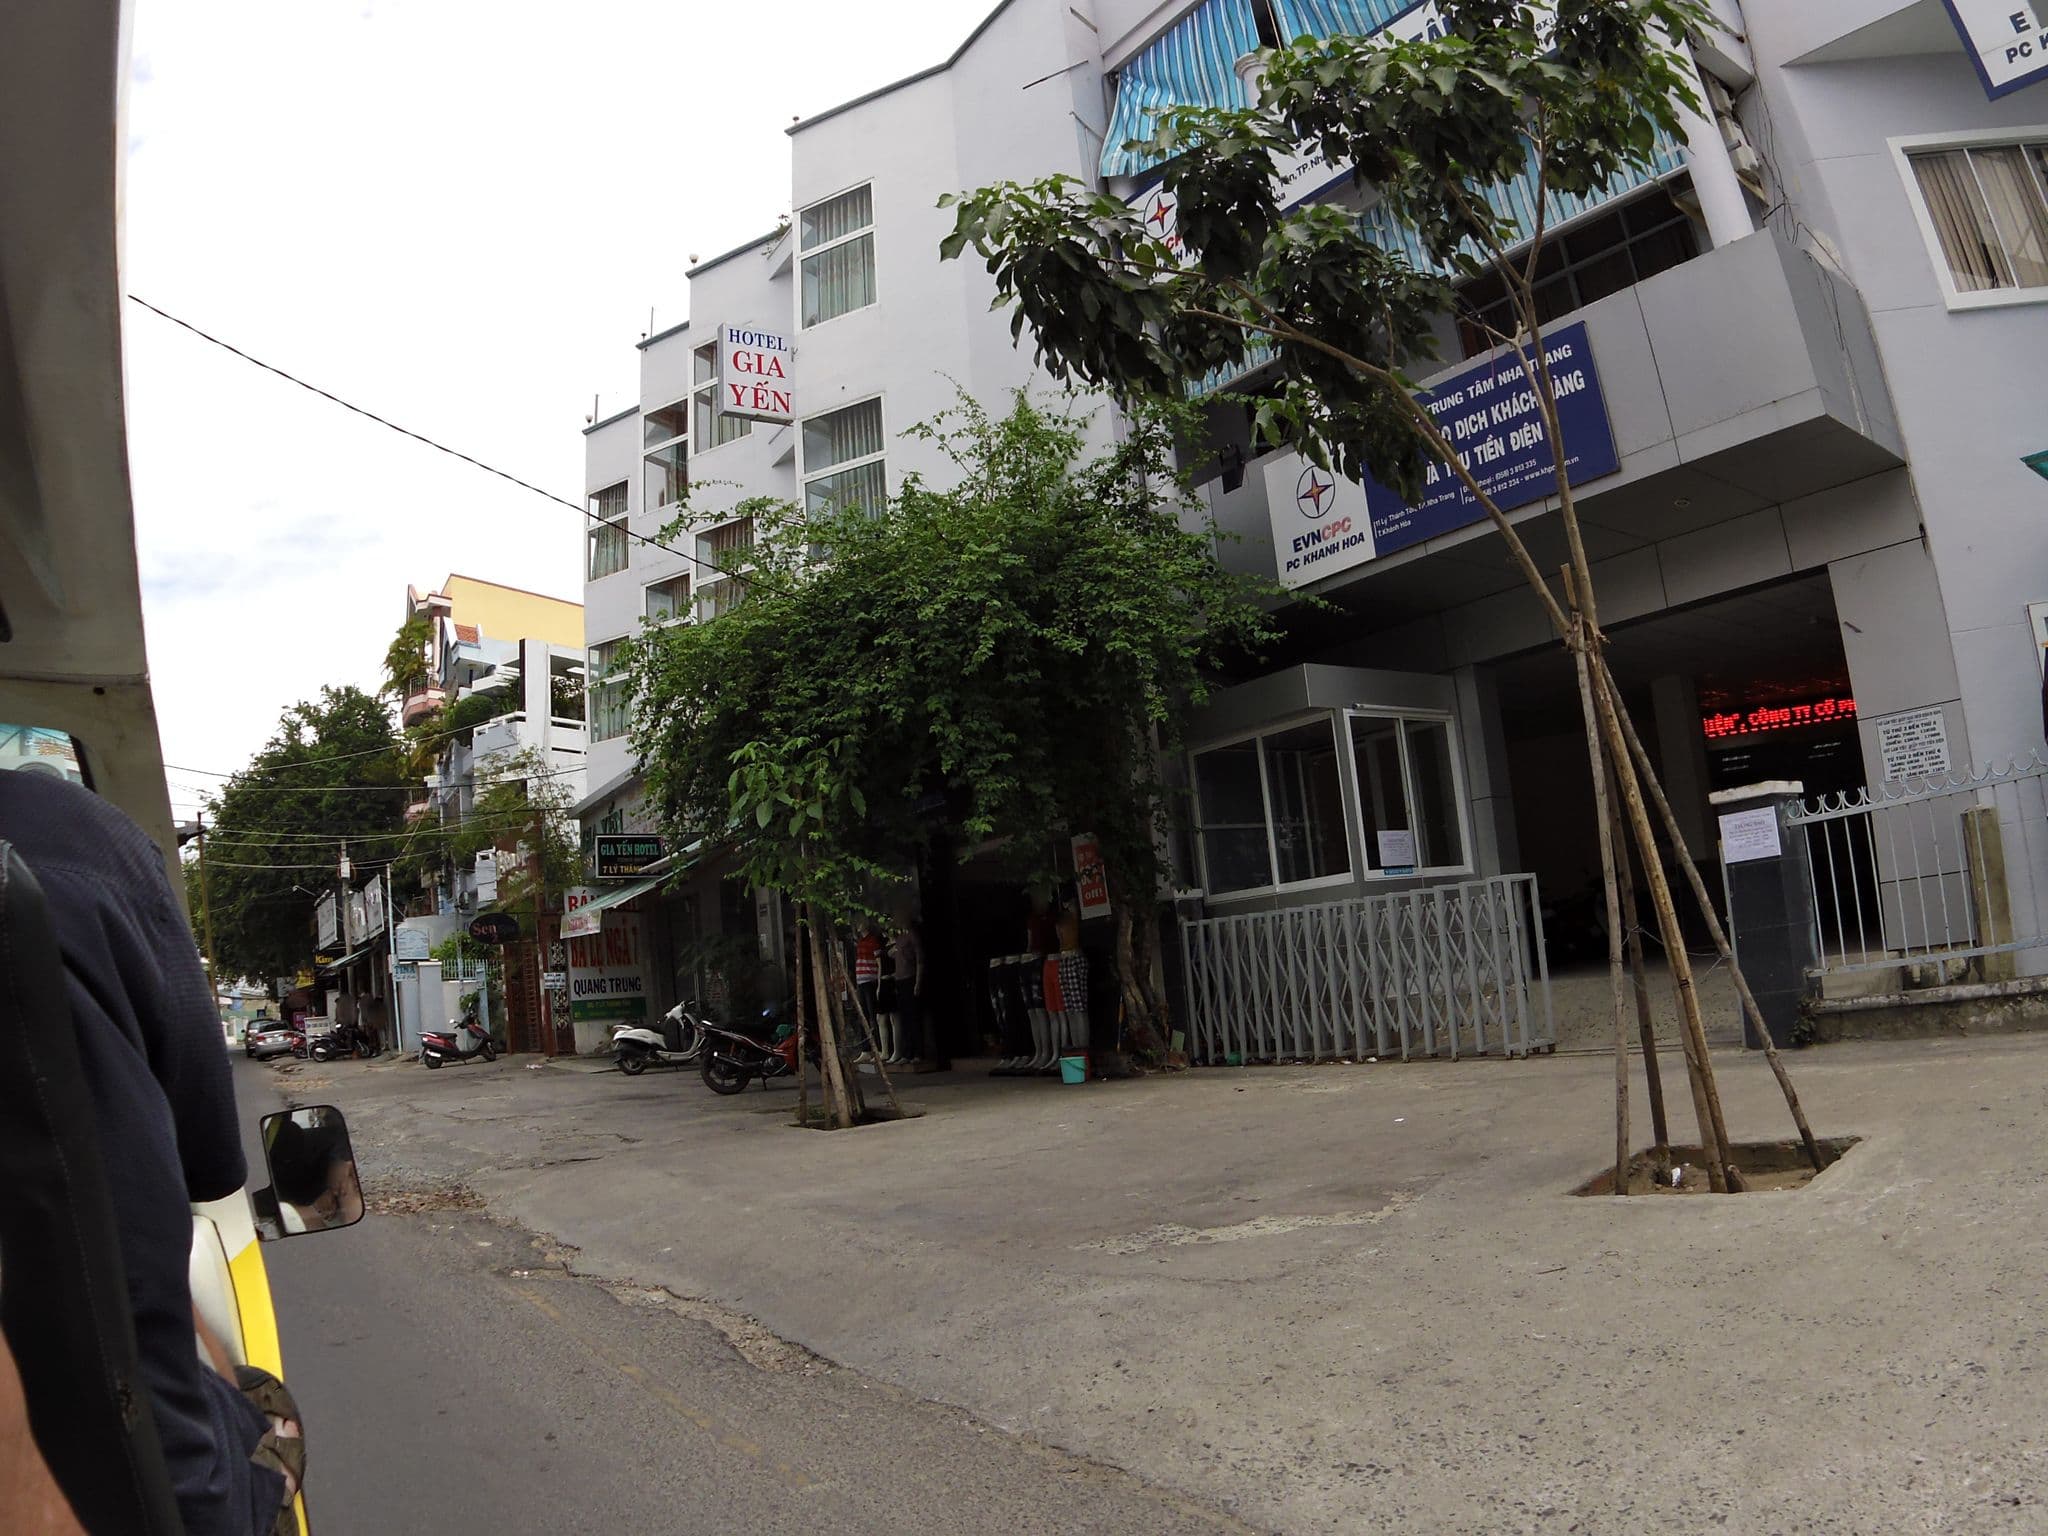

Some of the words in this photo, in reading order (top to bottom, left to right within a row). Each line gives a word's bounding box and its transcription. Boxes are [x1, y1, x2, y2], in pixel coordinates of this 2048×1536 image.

[2006, 42, 2032, 64] PC
[729, 328, 787, 352] HOTEL
[732, 350, 786, 378] GIA
[728, 381, 791, 413] YẾN
[1467, 377, 1495, 399] TÂM
[1499, 365, 1525, 387] NHA
[1455, 409, 1488, 440] DỊCH
[1551, 369, 1586, 401] ÀNG
[1474, 434, 1505, 465] TIỀN
[1510, 422, 1543, 452] ĐIỆN
[1293, 517, 1352, 552] EVNCPC
[1286, 559, 1300, 572] PC
[1303, 541, 1340, 566] KHANH
[1342, 532, 1365, 550] HOA
[600, 843, 615, 856] GIA
[616, 839, 633, 856] YẾN
[634, 843, 659, 856] HOTEL
[573, 978, 607, 997] QUANG
[608, 976, 642, 993] TRUNG
